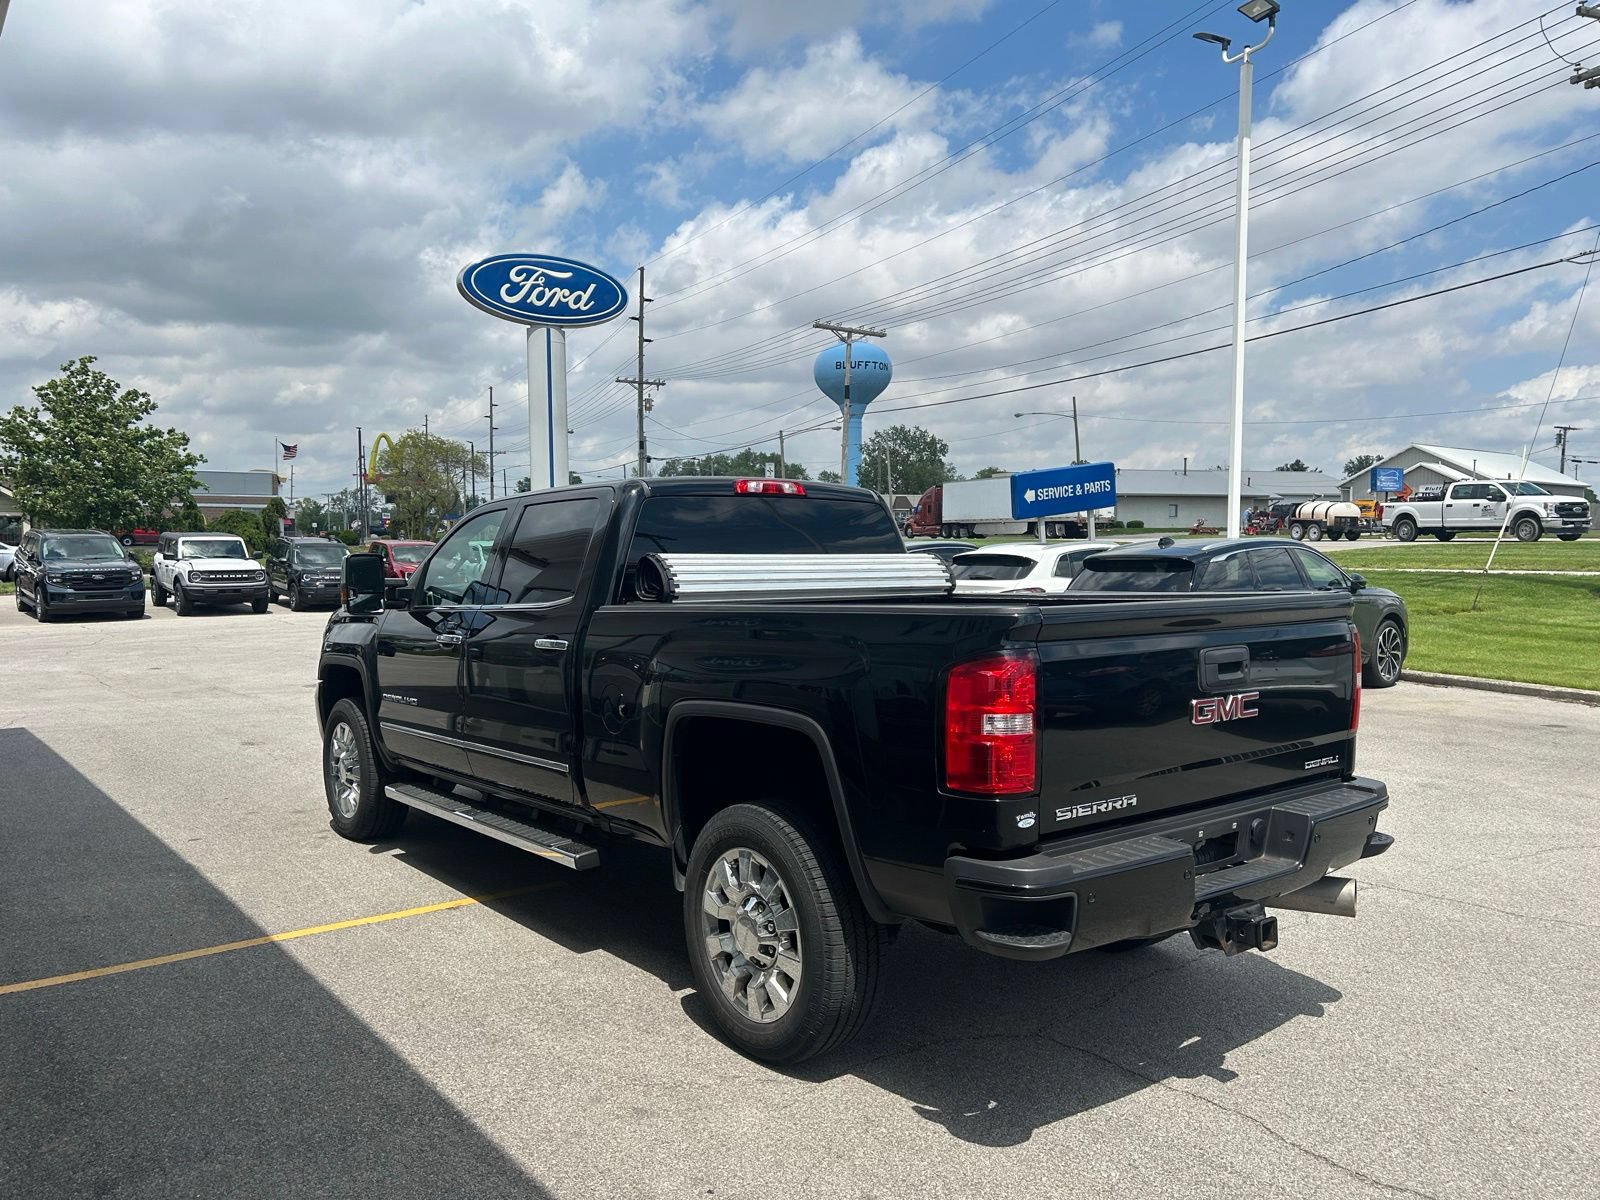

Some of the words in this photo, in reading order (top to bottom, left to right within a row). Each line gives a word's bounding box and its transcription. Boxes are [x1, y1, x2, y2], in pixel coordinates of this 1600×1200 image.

[500, 265, 597, 311] Ford
[835, 360, 889, 371] BLUFFTON
[1037, 485, 1074, 501] SERVICE
[1076, 484, 1083, 496] &
[1084, 480, 1111, 495] PARTS
[1191, 691, 1260, 725] GMC
[1016, 811, 1036, 821] Family
[1055, 794, 1138, 821] SIERRA
